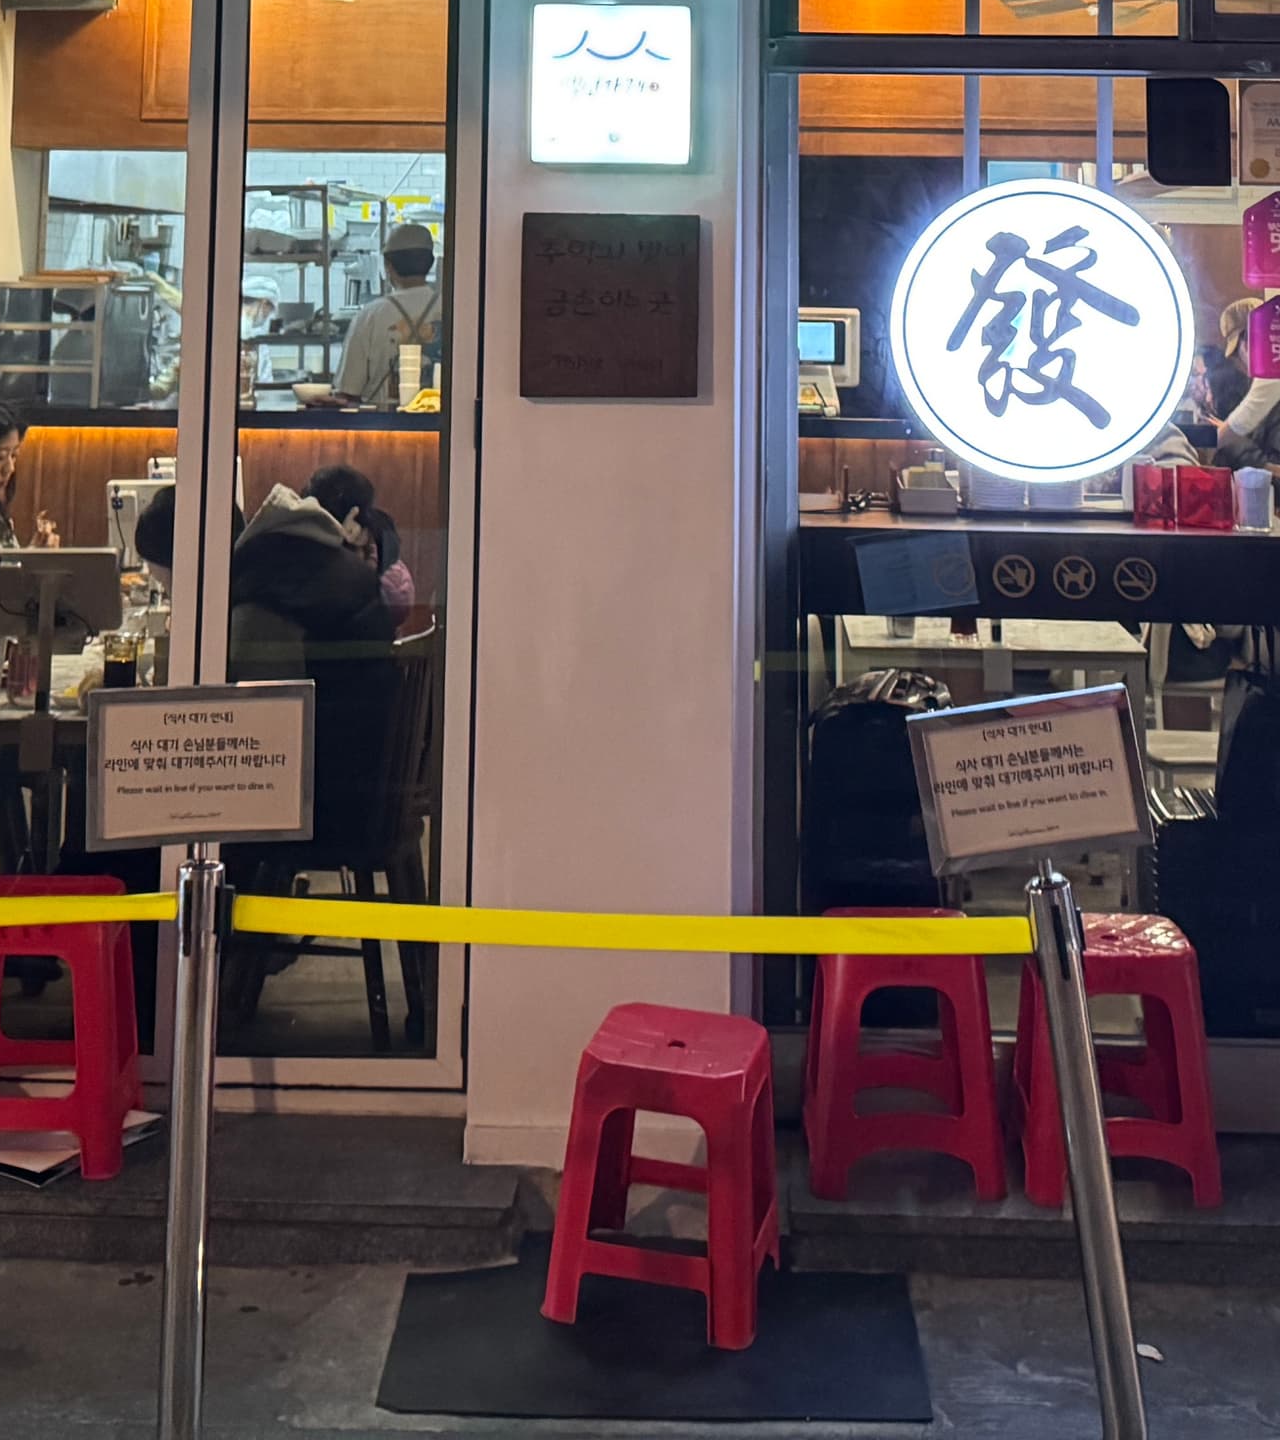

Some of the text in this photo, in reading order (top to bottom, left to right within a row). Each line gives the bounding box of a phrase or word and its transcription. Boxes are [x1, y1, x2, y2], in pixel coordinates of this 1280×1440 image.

[946, 225, 1141, 430] 發
[130, 736, 261, 753] 식사 대기 손님분들께서는
[955, 744, 1085, 773] 식사 대기 손님분들께서는
[104, 753, 287, 772] 라인에 맞춰 대기해주시기 바랍니다
[933, 758, 1114, 795] 라인에 맞춰 대기해주시기 바랍니다
